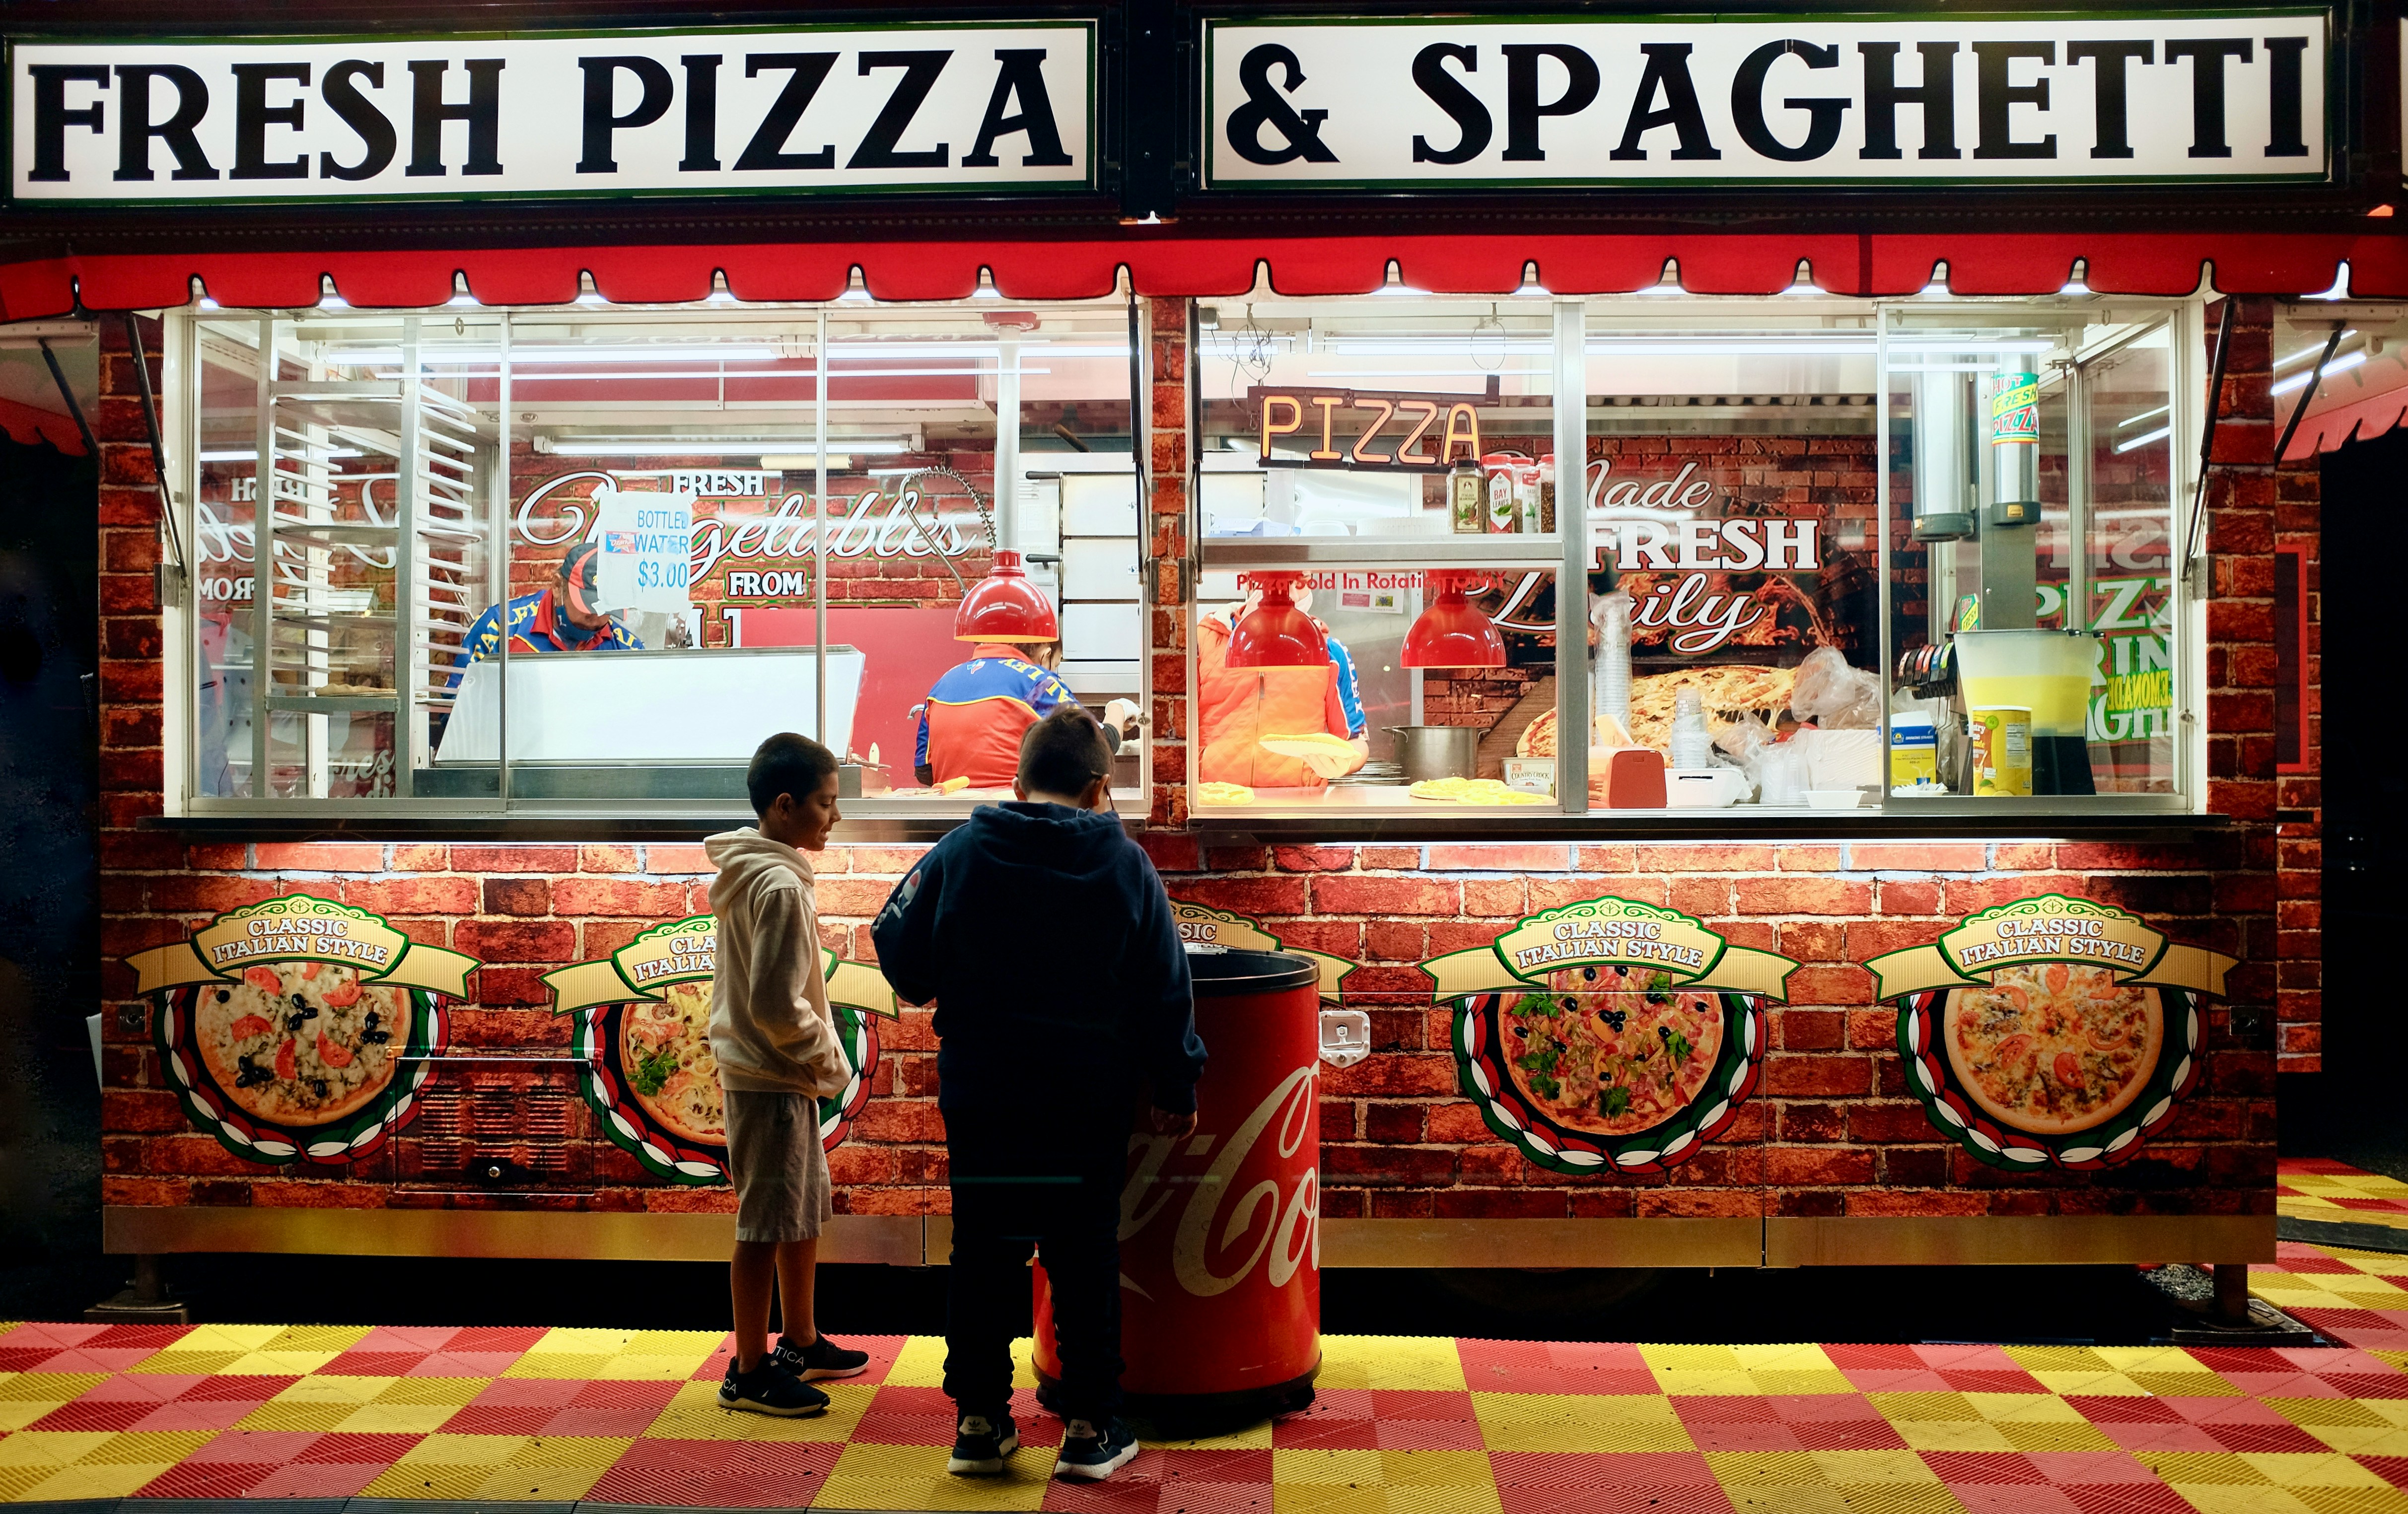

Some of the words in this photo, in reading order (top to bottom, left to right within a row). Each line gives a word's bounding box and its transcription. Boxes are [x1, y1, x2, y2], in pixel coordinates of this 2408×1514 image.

[1226, 43, 1340, 165] &
[1412, 36, 2309, 164] SPAGHETTI
[28, 58, 505, 182] FRESH
[575, 48, 1073, 174] PIZZA
[1992, 376, 2023, 397] HOT
[1995, 387, 2036, 413] FRESH
[1261, 396, 1481, 465] PIZZA
[673, 473, 765, 496] FRESH
[1494, 488, 1507, 499] BAY
[1492, 499, 1509, 508] LEAVES
[1587, 520, 1819, 570] FRESH
[637, 557, 688, 593] $3.00
[729, 571, 805, 596] FROM
[1237, 574, 1290, 591] Pizza
[1294, 572, 1336, 590] Sold
[1343, 572, 1359, 589] In
[247, 918, 349, 938] CLASSIC
[1553, 920, 1661, 941] CLASSIC
[1996, 918, 2104, 938] CLASSIC
[212, 936, 309, 964] ITALIAN
[316, 936, 388, 964] STYLE
[1516, 939, 1620, 968] ITALIAN
[1627, 940, 1702, 968] STYLE
[1959, 936, 2062, 966] ITALIAN
[2069, 937, 2145, 965] STYLE
